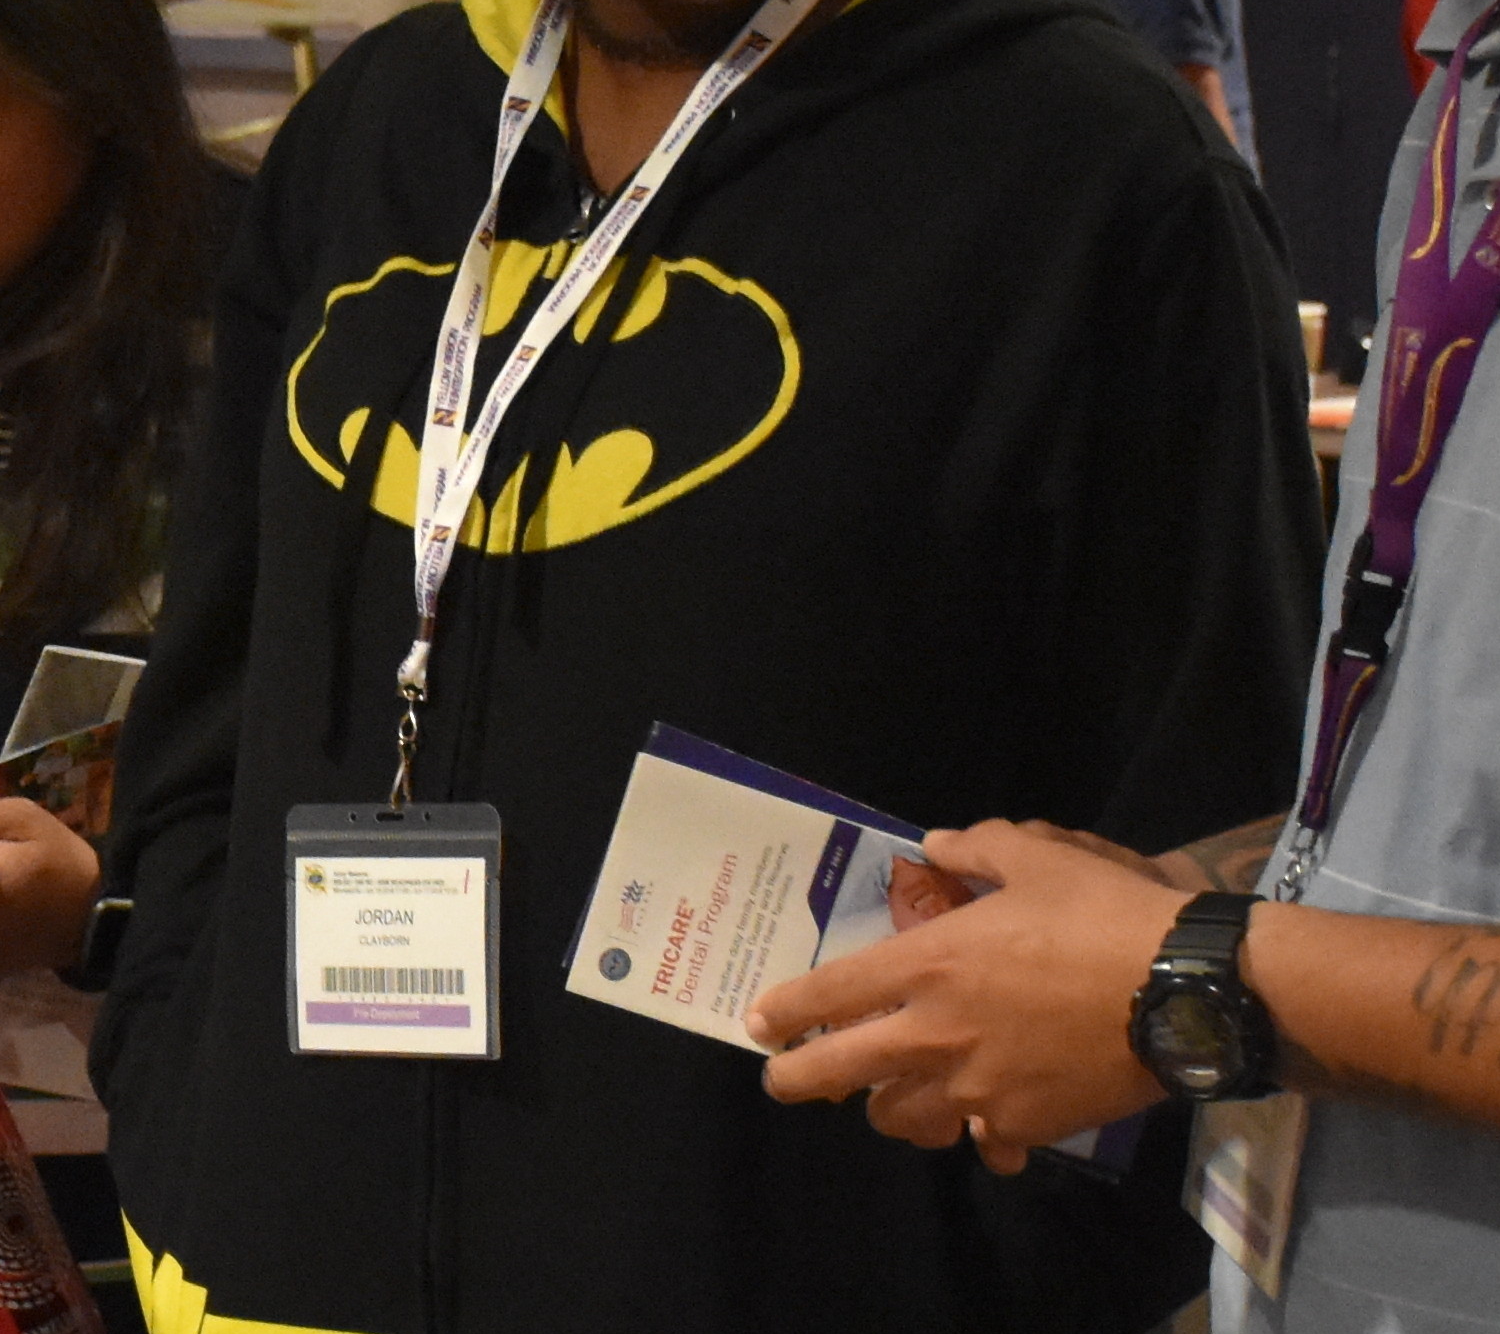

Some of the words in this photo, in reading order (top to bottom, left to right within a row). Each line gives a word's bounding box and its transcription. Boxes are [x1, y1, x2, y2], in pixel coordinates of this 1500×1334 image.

[355, 909, 414, 926] JORDAN
[676, 940, 709, 1006] Dental
[698, 854, 738, 936] Program
[359, 935, 411, 947] CLAYBORN
